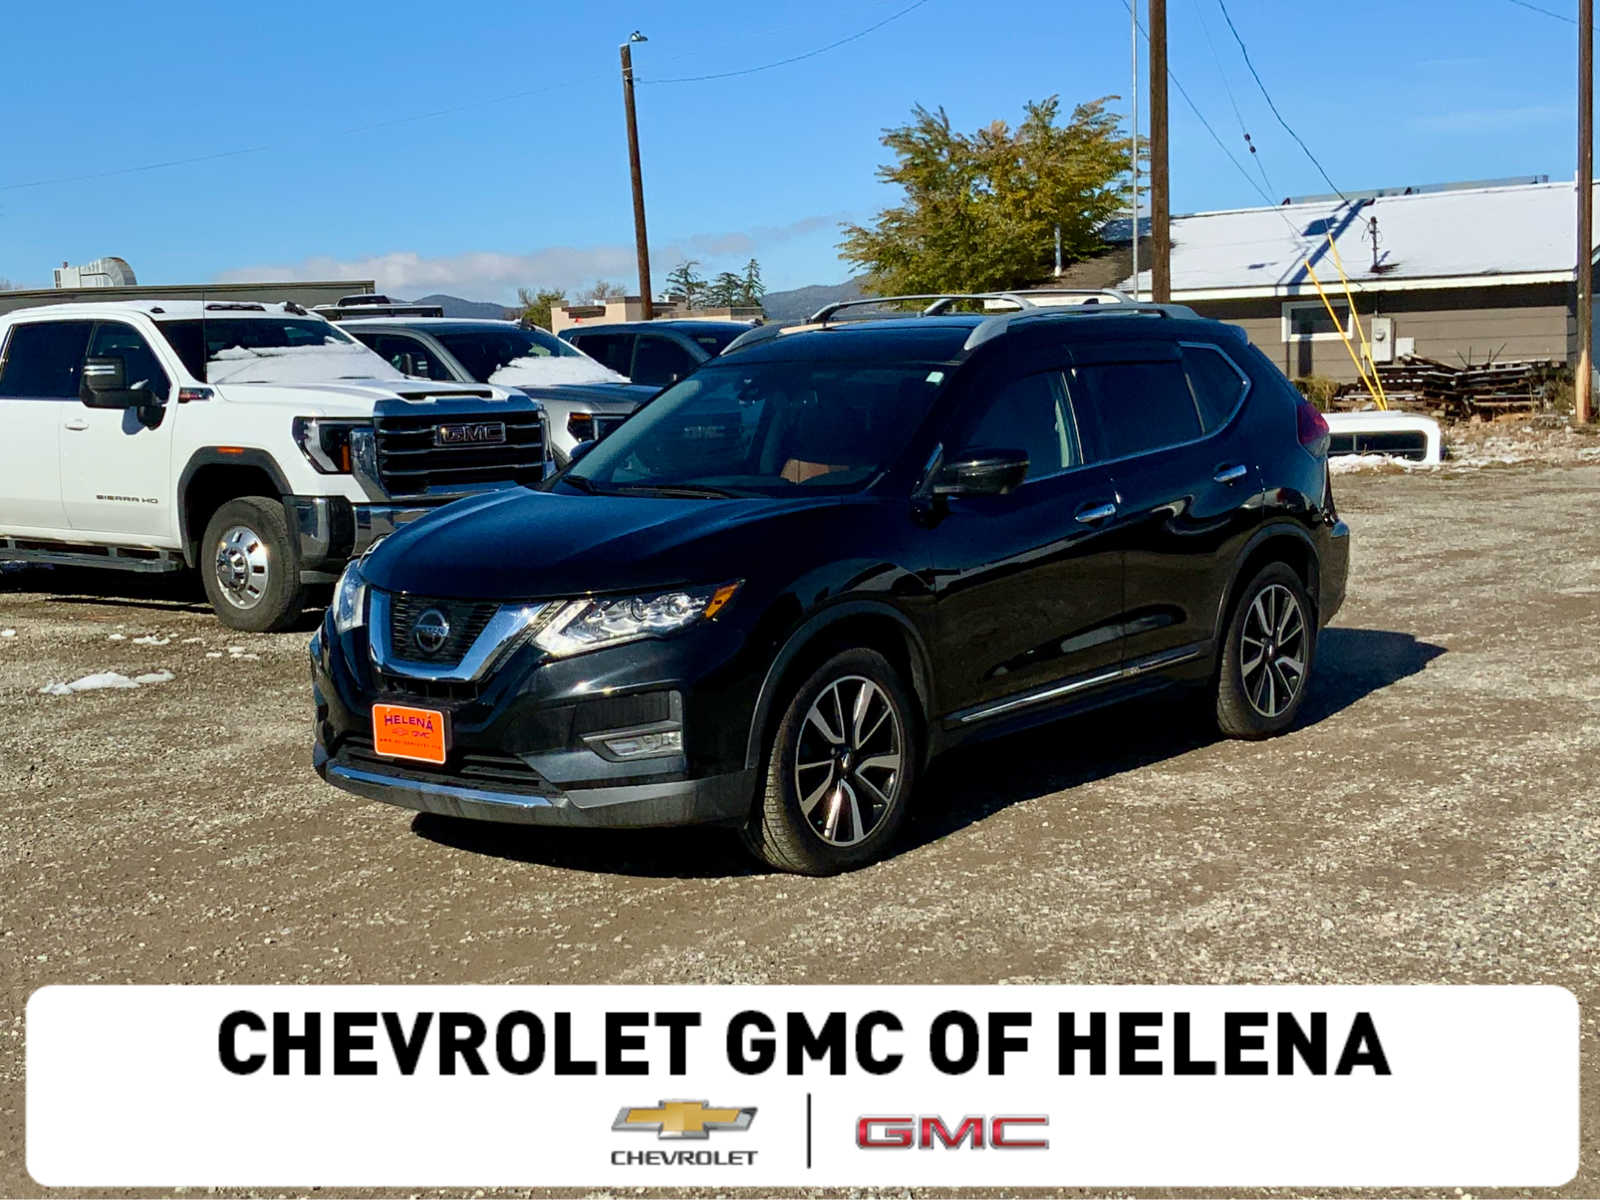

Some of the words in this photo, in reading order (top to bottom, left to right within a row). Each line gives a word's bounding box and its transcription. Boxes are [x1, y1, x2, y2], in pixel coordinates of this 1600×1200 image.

[440, 424, 503, 442] GMC
[95, 494, 140, 502] SIERRA
[384, 714, 434, 731] HELENA
